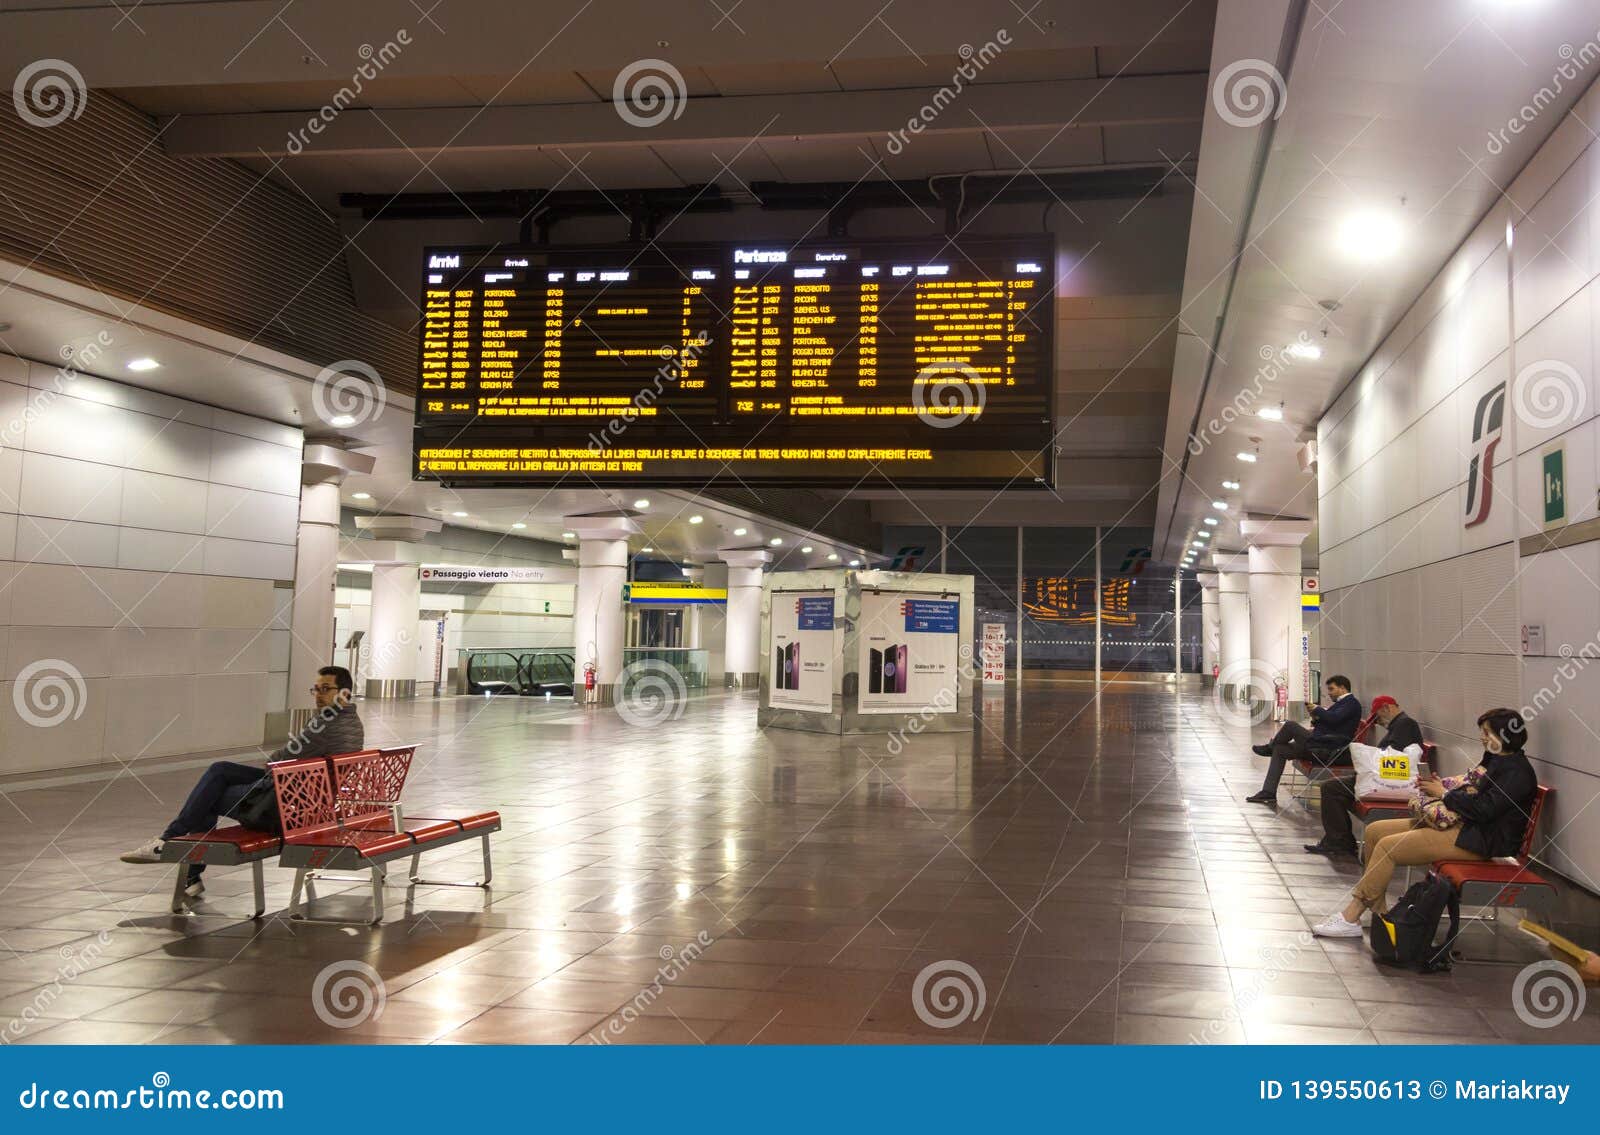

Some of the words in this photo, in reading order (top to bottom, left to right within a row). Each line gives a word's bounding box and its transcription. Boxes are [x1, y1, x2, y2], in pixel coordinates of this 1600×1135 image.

[472, 450, 518, 458] SEVERAMENTE
[520, 450, 548, 458] VIETATO
[550, 450, 602, 458] OLTREPASSARE
[602, 450, 612, 458] LA
[614, 450, 635, 458] LINEA
[637, 450, 662, 458] GIALLA
[664, 450, 669, 458] E
[671, 450, 696, 458] SALIRE
[699, 450, 704, 458] O
[706, 450, 742, 458] SCENDERE
[743, 450, 756, 458] DAI
[759, 450, 779, 458] TRENI
[781, 450, 809, 458] QUANDO
[810, 450, 825, 458] NON
[827, 450, 845, 458] SONO
[848, 450, 905, 459] COMPLETAMENTE
[428, 461, 456, 470] VIETATO
[458, 462, 508, 470] OLTREPASSARE
[509, 462, 519, 470] LA
[521, 462, 542, 470] LINEA
[543, 462, 568, 470] GIALLA
[570, 462, 578, 470] IN
[580, 462, 606, 470] ATTESA
[607, 462, 620, 470] DEI
[622, 462, 642, 471] TRENI
[433, 570, 476, 579] Passaggio
[478, 570, 508, 578] vietato
[511, 570, 523, 578] No
[525, 571, 544, 579] entry
